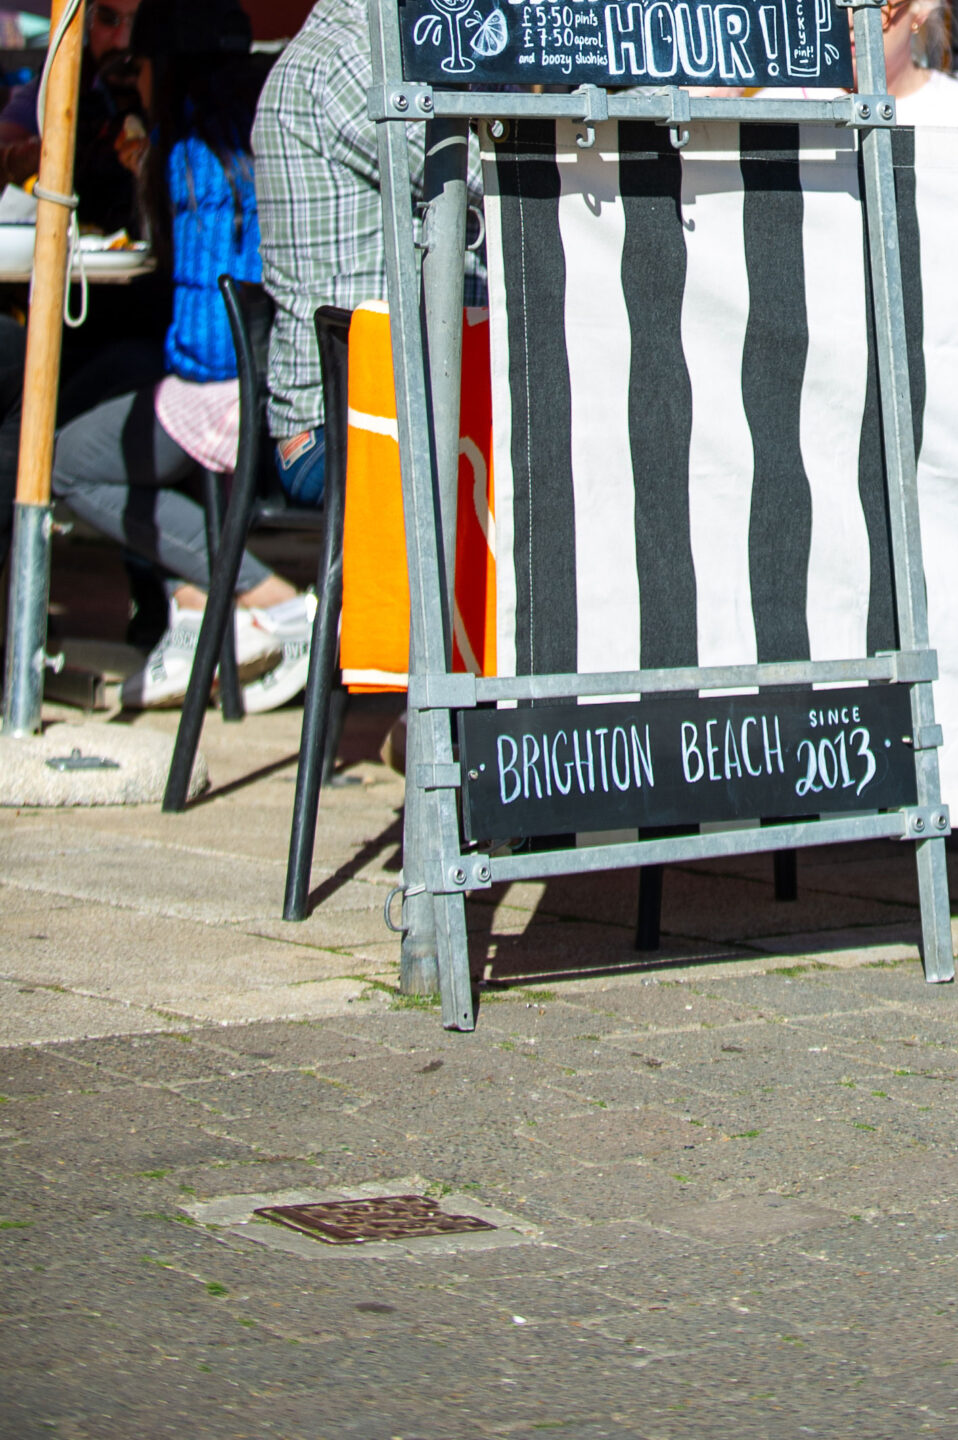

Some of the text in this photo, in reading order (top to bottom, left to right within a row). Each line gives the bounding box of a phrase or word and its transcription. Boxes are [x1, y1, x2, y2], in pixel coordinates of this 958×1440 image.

[574, 9, 599, 28] pints
[574, 31, 603, 50] aperol
[518, 51, 536, 65] and
[541, 49, 572, 74] boozy
[809, 706, 861, 728] SINCE
[496, 715, 785, 804] BRIGHTON BEACH
[795, 727, 876, 797] 2013
